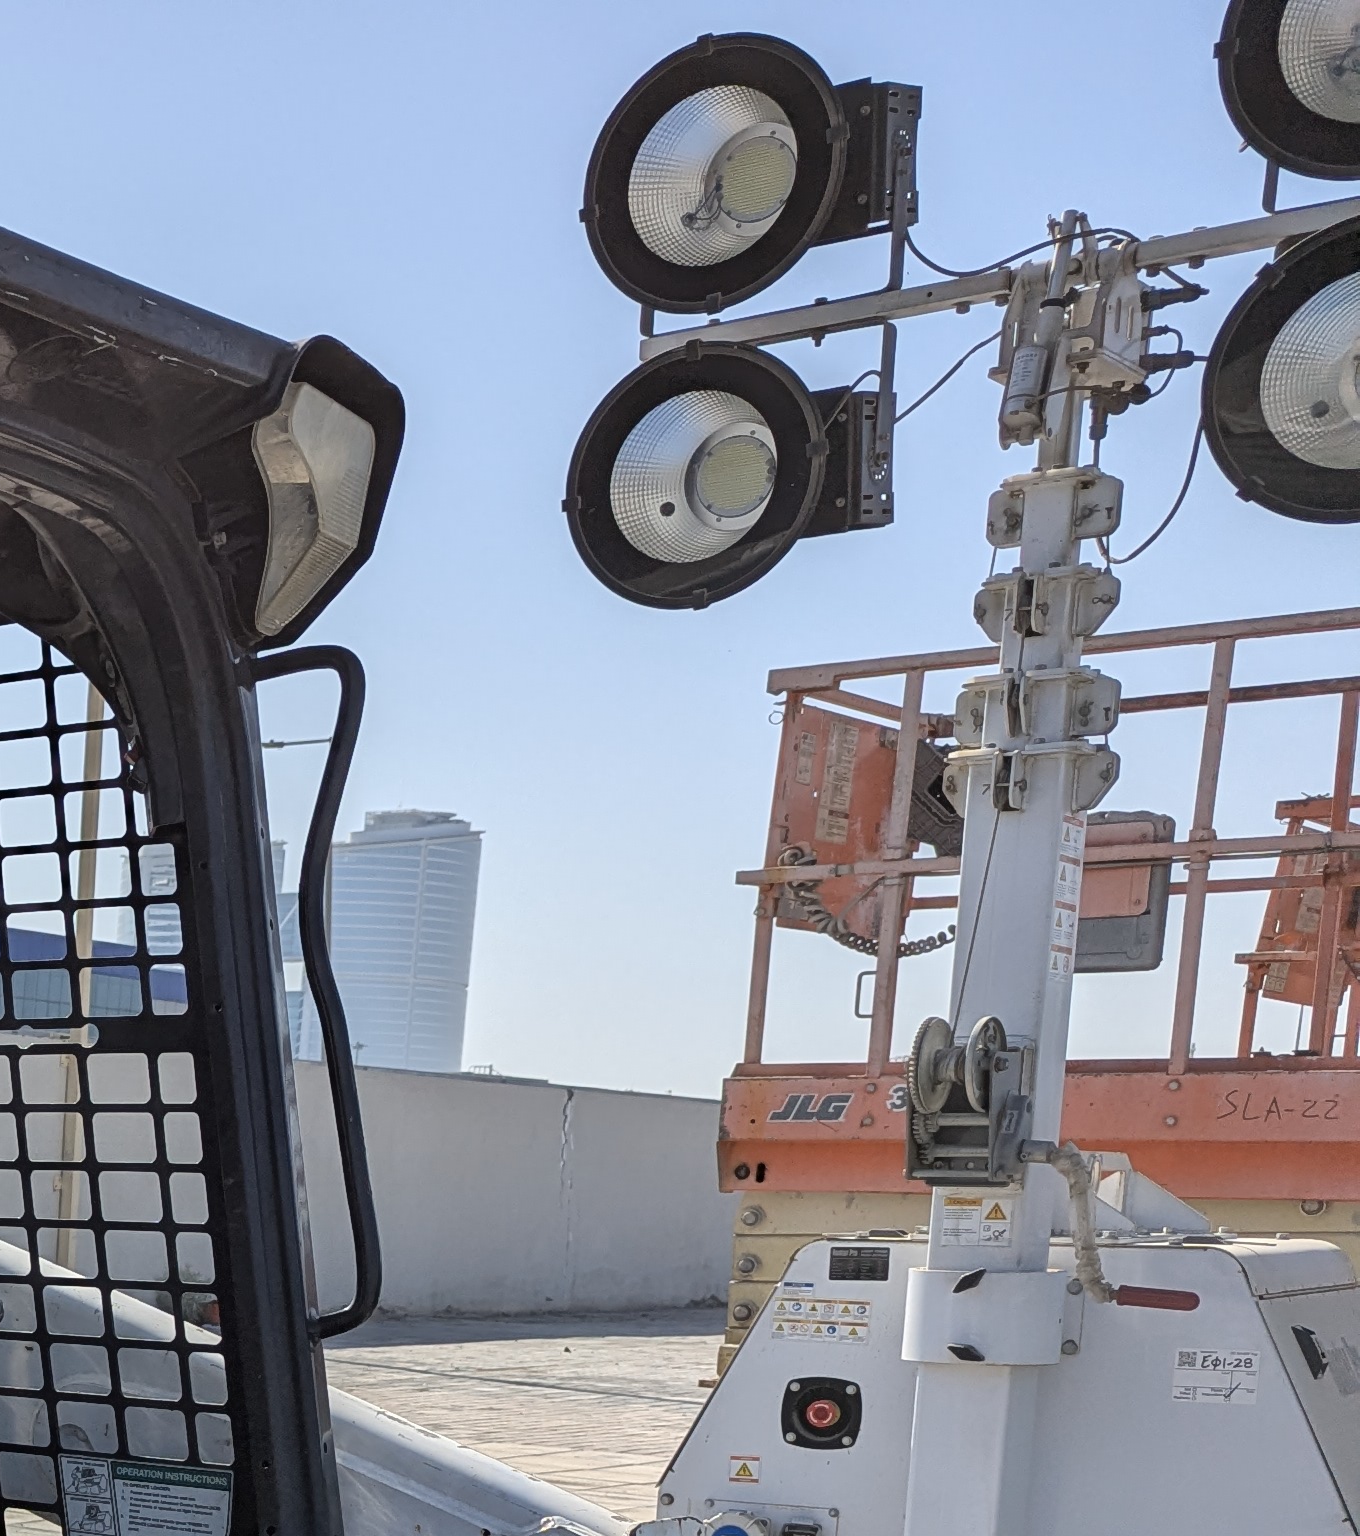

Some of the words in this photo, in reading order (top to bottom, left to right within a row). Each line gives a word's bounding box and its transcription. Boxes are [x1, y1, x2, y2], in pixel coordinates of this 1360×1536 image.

[767, 1093, 854, 1122] JLG
[1217, 1089, 1339, 1122] SLA-22
[116, 1466, 164, 1480] OPERATION
[165, 1471, 228, 1486] INSTRUCTIONS
